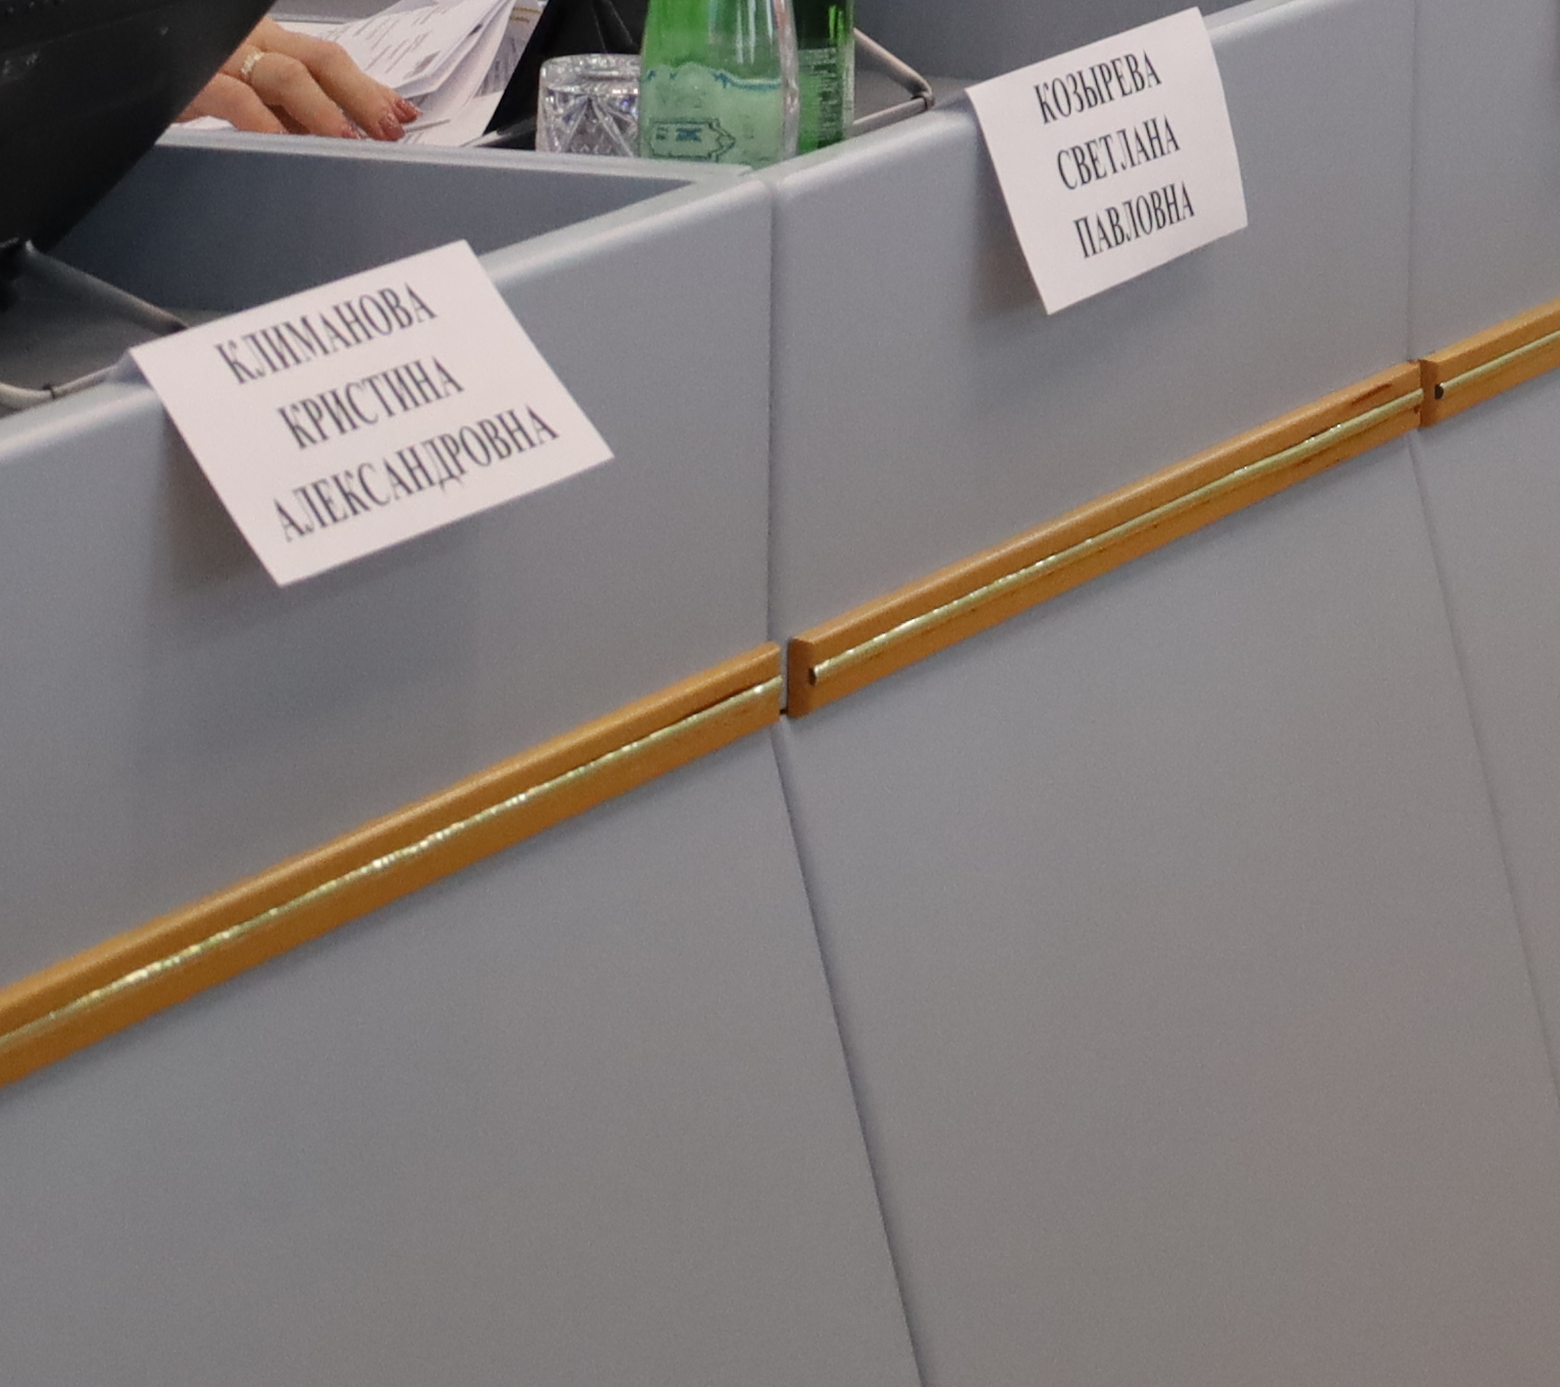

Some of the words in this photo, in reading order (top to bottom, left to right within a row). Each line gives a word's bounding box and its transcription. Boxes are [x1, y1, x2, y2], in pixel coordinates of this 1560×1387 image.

[1034, 49, 1162, 125] КОЗЫРЕВА
[1056, 114, 1181, 191] СВЕТЛАНА
[1073, 181, 1196, 260] ПАВЛОВНА
[213, 282, 438, 385] КЛИМАНОВА
[277, 355, 465, 450] КРИСТИНА
[271, 404, 560, 543] АЛЕКСАНДРОВНА
